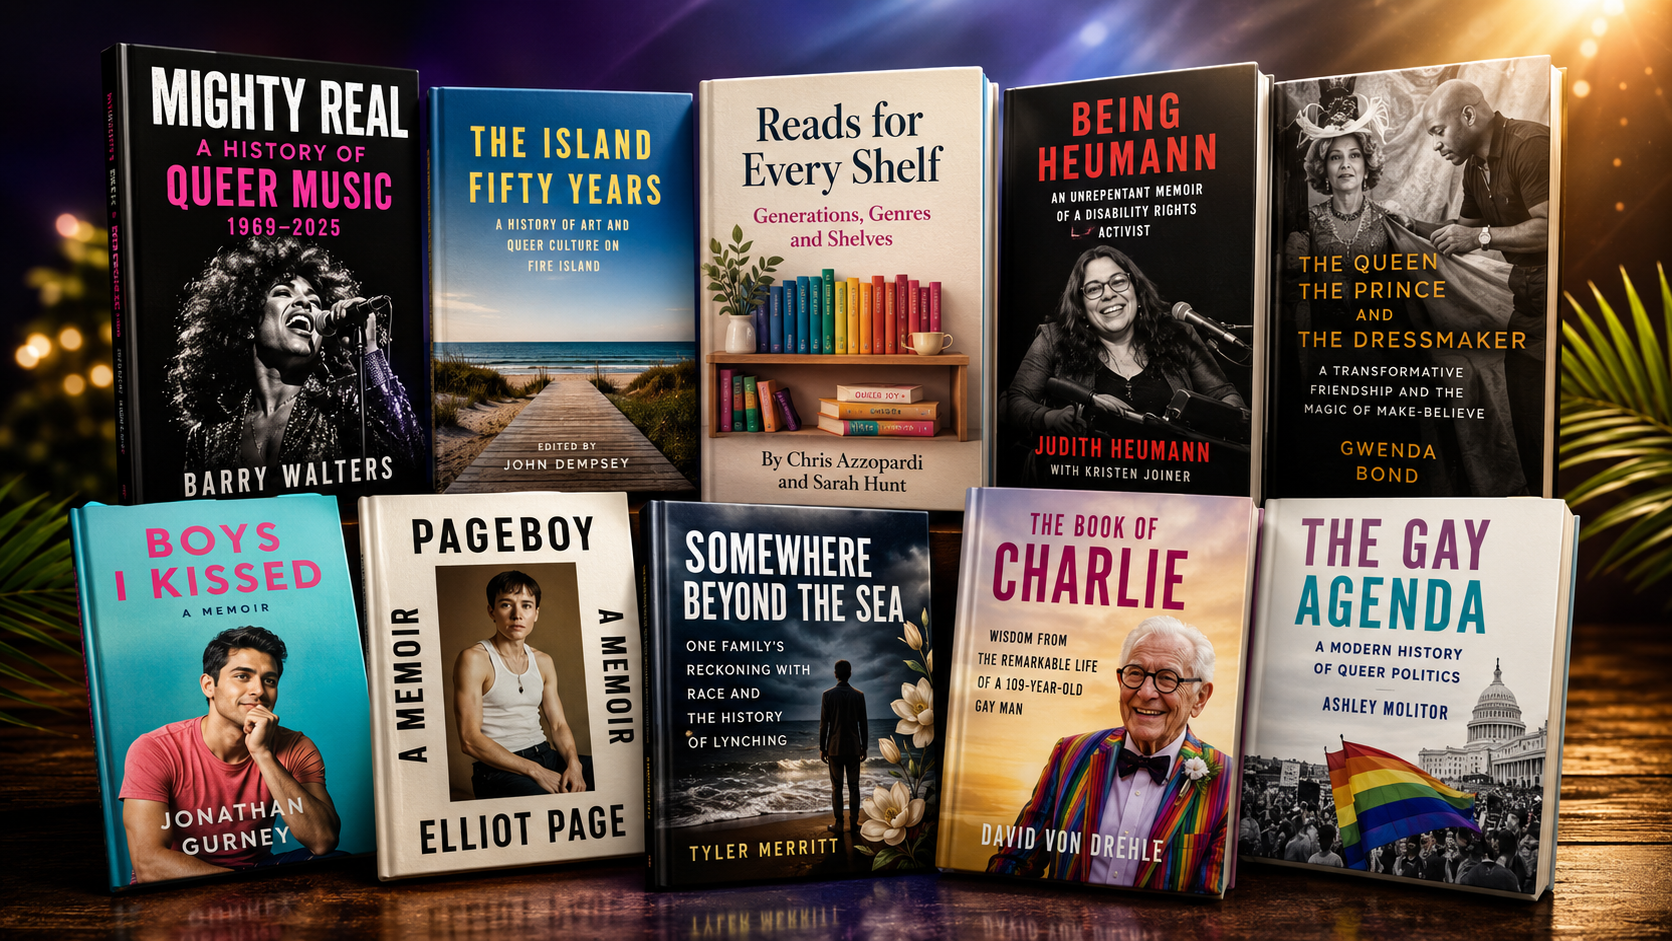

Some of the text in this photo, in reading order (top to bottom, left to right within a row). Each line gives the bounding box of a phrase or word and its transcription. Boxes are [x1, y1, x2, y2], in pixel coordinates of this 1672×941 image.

[151, 67, 306, 132] MIGHTY
[321, 80, 409, 138] REAL
[756, 100, 924, 143] Reads for
[1072, 92, 1180, 136] BEING
[196, 139, 366, 163] A HISTORY OF
[470, 126, 651, 160] THE ISLAND
[1038, 133, 1217, 182] HEUMANN
[742, 145, 944, 196] Every Shelf
[166, 164, 277, 210] QUEER
[292, 169, 392, 211] MUSIC
[469, 172, 661, 205] FIFTY YEARS
[1051, 183, 1203, 204] AN UNREPENTANT MEMOIR
[753, 204, 931, 225] Generations, Genres
[1057, 203, 1197, 222] OF A DISABILITY RIGHTS
[496, 219, 629, 231] A HISTORY OF ART AND
[1098, 225, 1151, 238] ACTIVIST
[507, 240, 619, 252] QUEER CULTURE ON
[790, 229, 893, 248] and Shelves
[528, 260, 600, 272] FIRE ISLAND
[1299, 253, 1438, 274] THE QUEEN
[1299, 281, 1446, 300] THE PRINCE
[1356, 309, 1392, 321] AND
[1298, 332, 1526, 349] THE DRESSMAKER
[1319, 366, 1463, 378] A TRANSFORMATIVE
[1310, 384, 1463, 398] FRIENDSHIP AND THE
[1304, 404, 1484, 419] MAGIC OF MAKE-BELIEVE
[538, 442, 596, 451] EDITED BY
[1035, 435, 1210, 463] JUDITH HEUMANN
[1341, 441, 1436, 460] GWENDA
[503, 457, 629, 471] JOHN DEMPSEY
[761, 451, 923, 472] By Chris Azzopardi
[184, 456, 393, 497] BARRY WALTERS
[778, 474, 906, 493] and Sarah Hunt
[1051, 464, 1190, 482] WITH KRISTEN JOINER
[1356, 466, 1418, 484] BOND
[412, 516, 593, 554] PAGEBOY
[1030, 512, 1159, 540] THE BOOK OF
[146, 522, 280, 558] BOYS
[1302, 518, 1491, 570] THE GAY
[685, 530, 872, 578] SOMEWHERE
[115, 560, 322, 601] I KISSED
[992, 541, 1188, 610] CHARLIE
[182, 603, 270, 618] A MEMOIR
[684, 581, 904, 623] BEYOND THE SEA
[1294, 574, 1486, 634] AGENDA
[687, 640, 784, 652] ONE FAMILY'S
[990, 629, 1067, 647] WISDOM FROM
[1315, 641, 1463, 660] A MODERN HISTORY
[687, 664, 810, 676] RECKONING WITH
[978, 652, 1098, 673] THE REMARKABLE LIFE
[1314, 662, 1461, 683] OF QUEER POLITICS
[391, 608, 428, 763] A MEMOIR
[599, 609, 634, 745] A MEMOIR
[977, 675, 1083, 696] OF A 109-YEAR-OLD
[687, 687, 760, 700] RACE AND
[688, 711, 783, 725] THE HISTORY
[975, 699, 1023, 716] GAY MAN
[1323, 696, 1448, 721] ASHLEY MOLITOR
[688, 734, 787, 749] OF LYNCHING
[161, 797, 304, 831] JONATHAN
[182, 825, 289, 855] GURNEY
[420, 804, 626, 855] ELLIOT PAGE
[689, 838, 839, 862] TYLER MERRITT
[981, 822, 1164, 863] DAVID VON DREHLE
